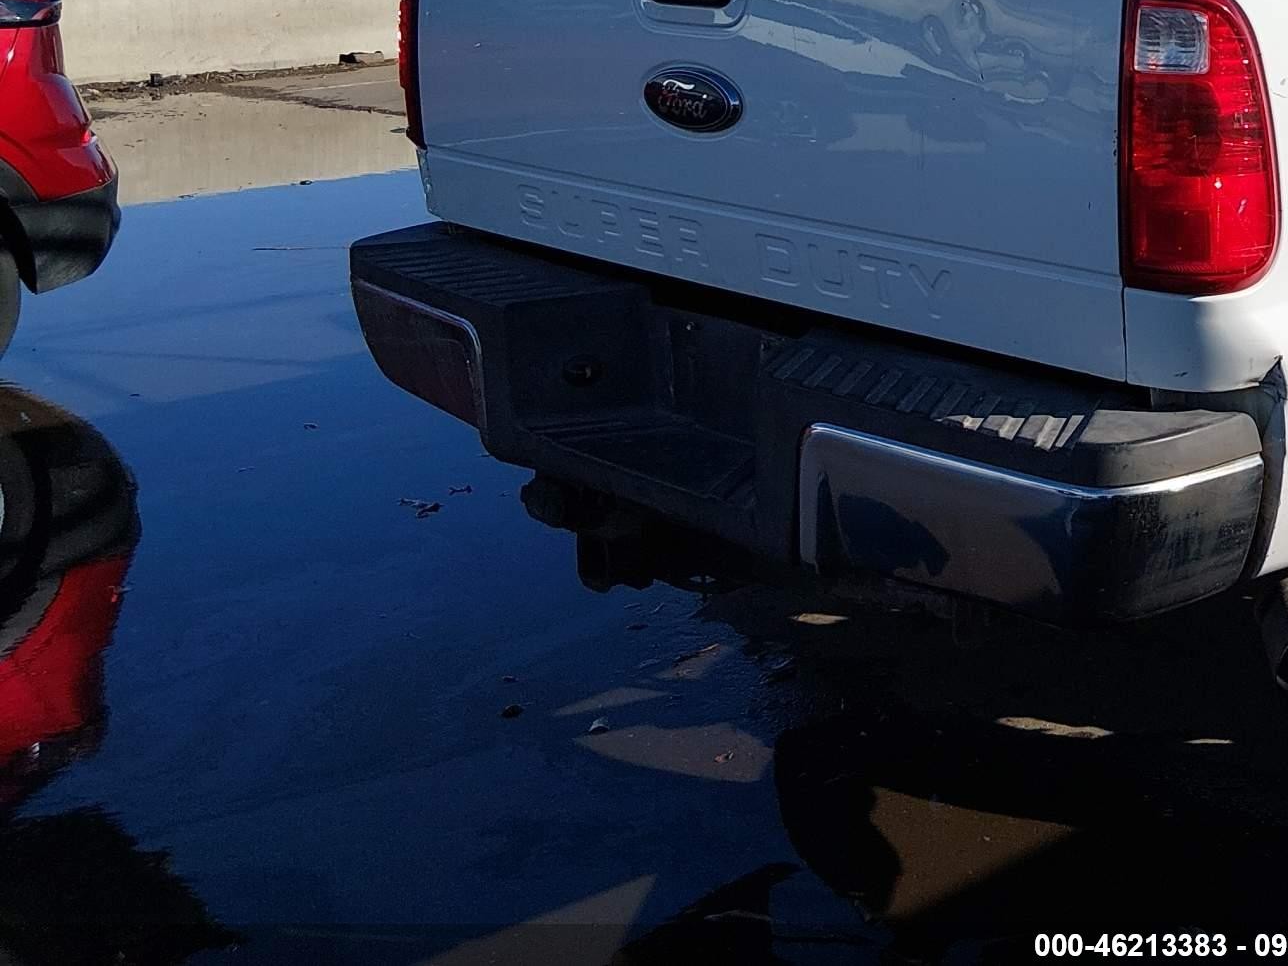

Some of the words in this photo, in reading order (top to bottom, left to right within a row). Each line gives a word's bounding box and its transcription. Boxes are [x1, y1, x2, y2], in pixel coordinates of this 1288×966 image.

[657, 78, 714, 120] Ford
[515, 183, 710, 269] SUPER
[754, 232, 953, 320] DUTY
